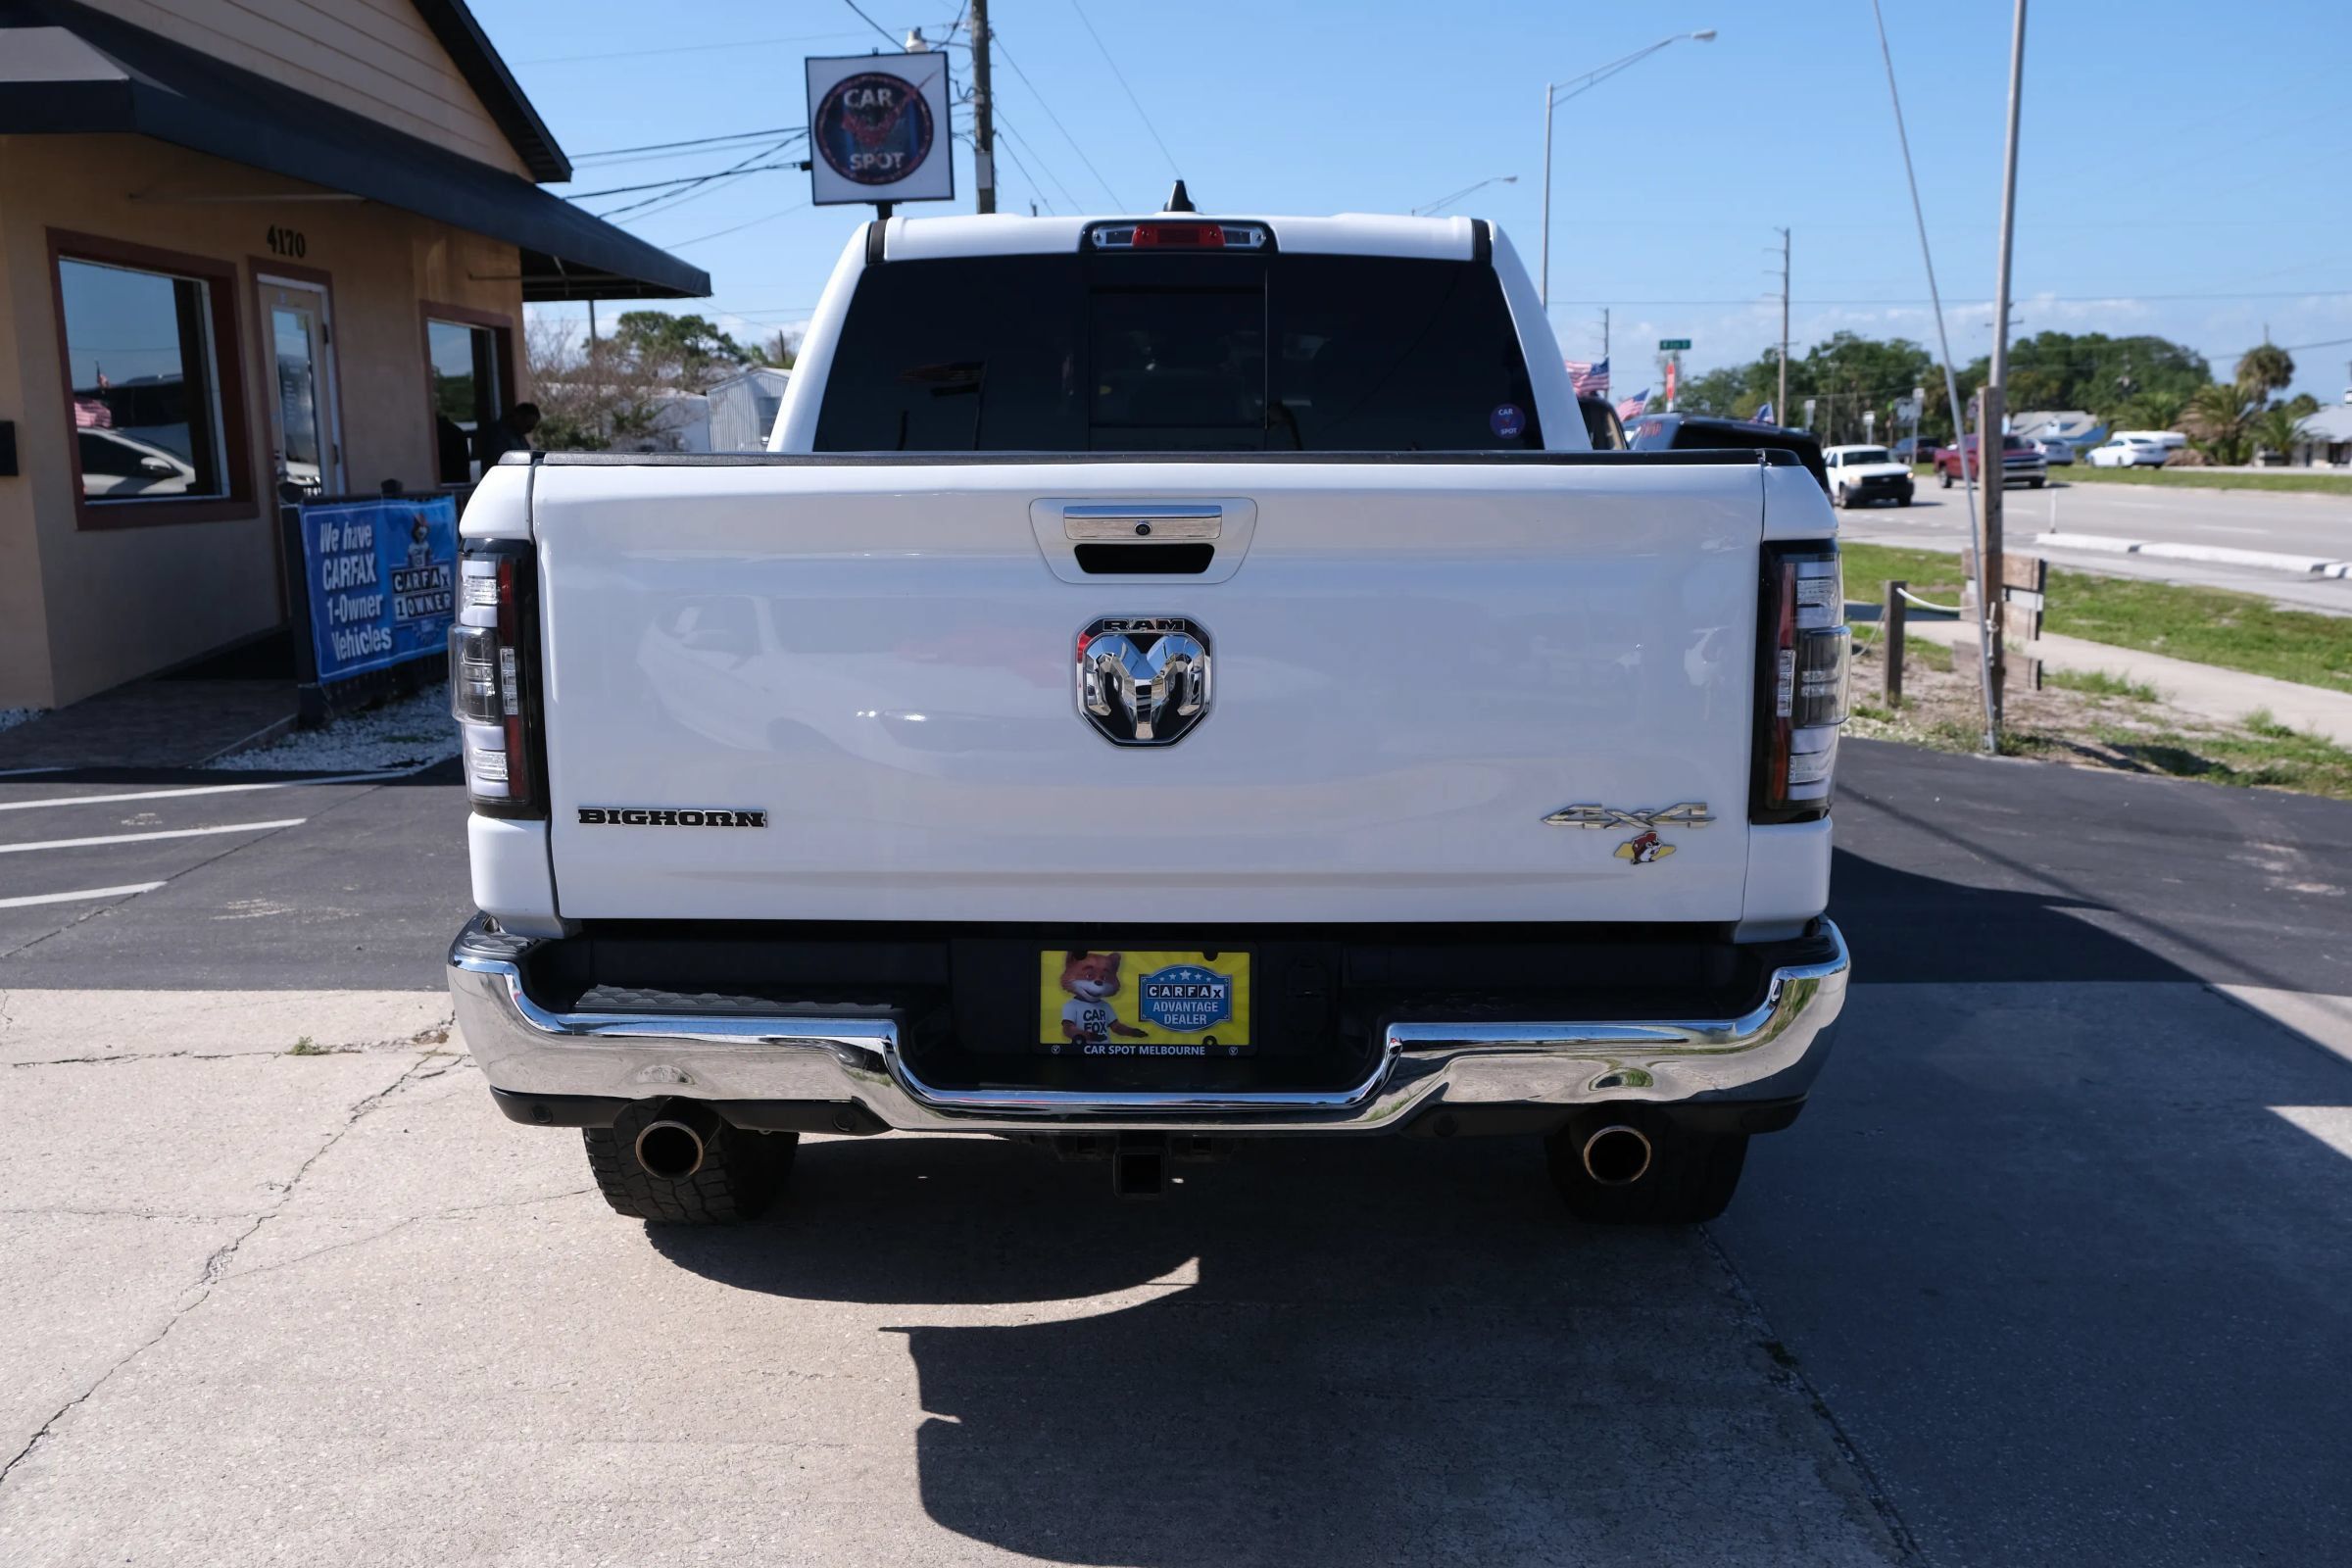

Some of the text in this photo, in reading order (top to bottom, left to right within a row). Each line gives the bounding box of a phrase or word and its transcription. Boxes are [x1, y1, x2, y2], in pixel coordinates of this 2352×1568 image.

[843, 88, 894, 109] CAR
[849, 152, 905, 172] SPOT
[267, 224, 306, 259] 4170
[319, 521, 372, 553] We have
[322, 553, 376, 592] CARFAX
[394, 569, 451, 592] CARFAX
[326, 594, 383, 625] 1-Owner
[1102, 619, 1185, 631] RAM
[331, 624, 392, 662] Vehicles
[578, 808, 768, 828] BIGHORN
[1148, 985, 1223, 999] CARFAX
[1083, 1009, 1106, 1021] CAR
[1152, 1002, 1218, 1012] ADVANTAGE
[1084, 1021, 1107, 1033] FOX
[1164, 1013, 1207, 1025] DEALER
[1084, 1045, 1205, 1055] CAR SPOT MELBOURNE
